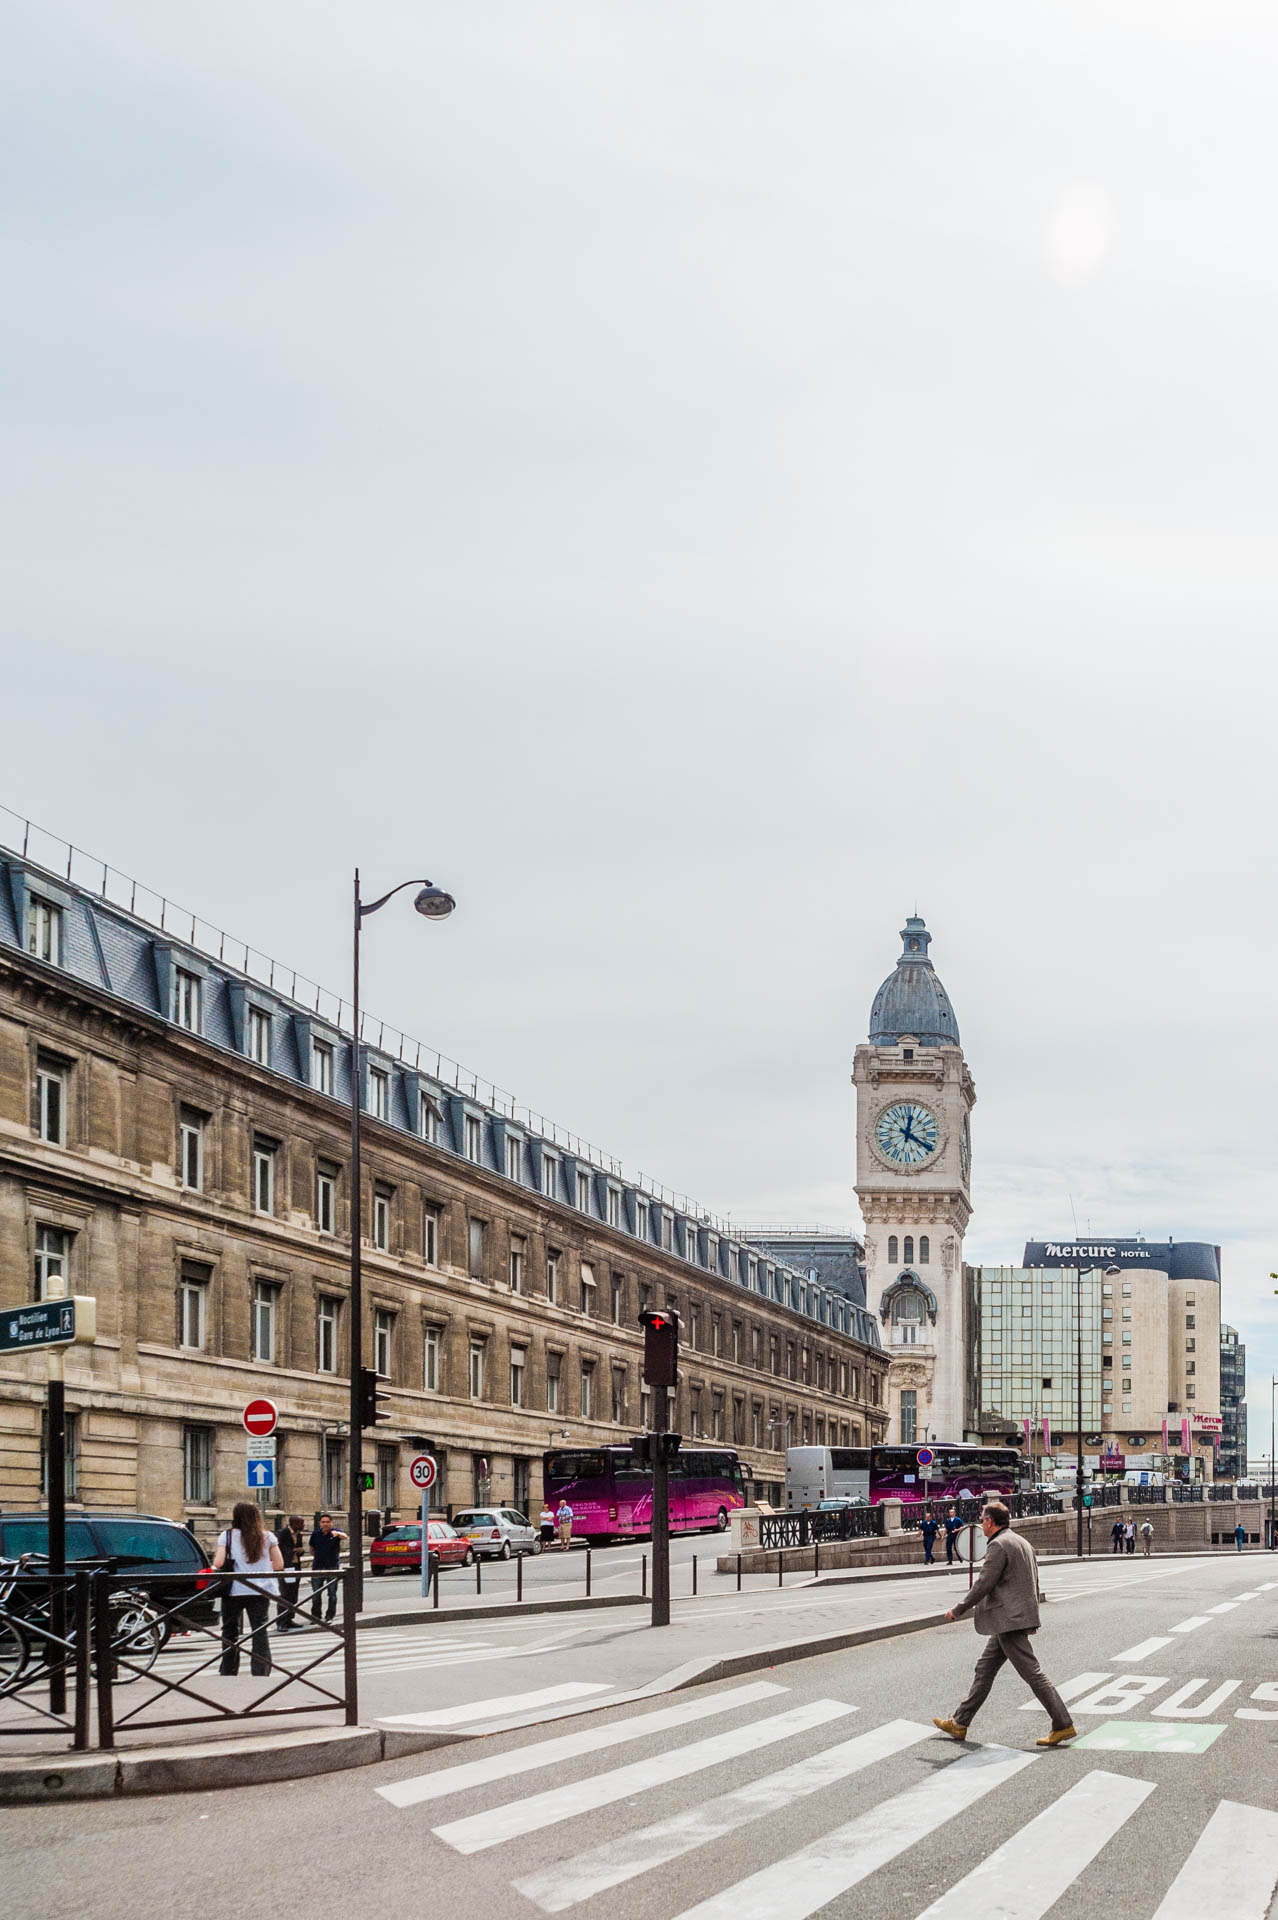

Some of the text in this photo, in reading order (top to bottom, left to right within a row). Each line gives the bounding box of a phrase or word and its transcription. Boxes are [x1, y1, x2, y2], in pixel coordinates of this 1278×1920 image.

[1044, 1243, 1151, 1258] Mercure HOTEL
[19, 1312, 48, 1325] Noctilien
[19, 1326, 60, 1341] Gare de Lyon
[415, 1465, 430, 1479] 30
